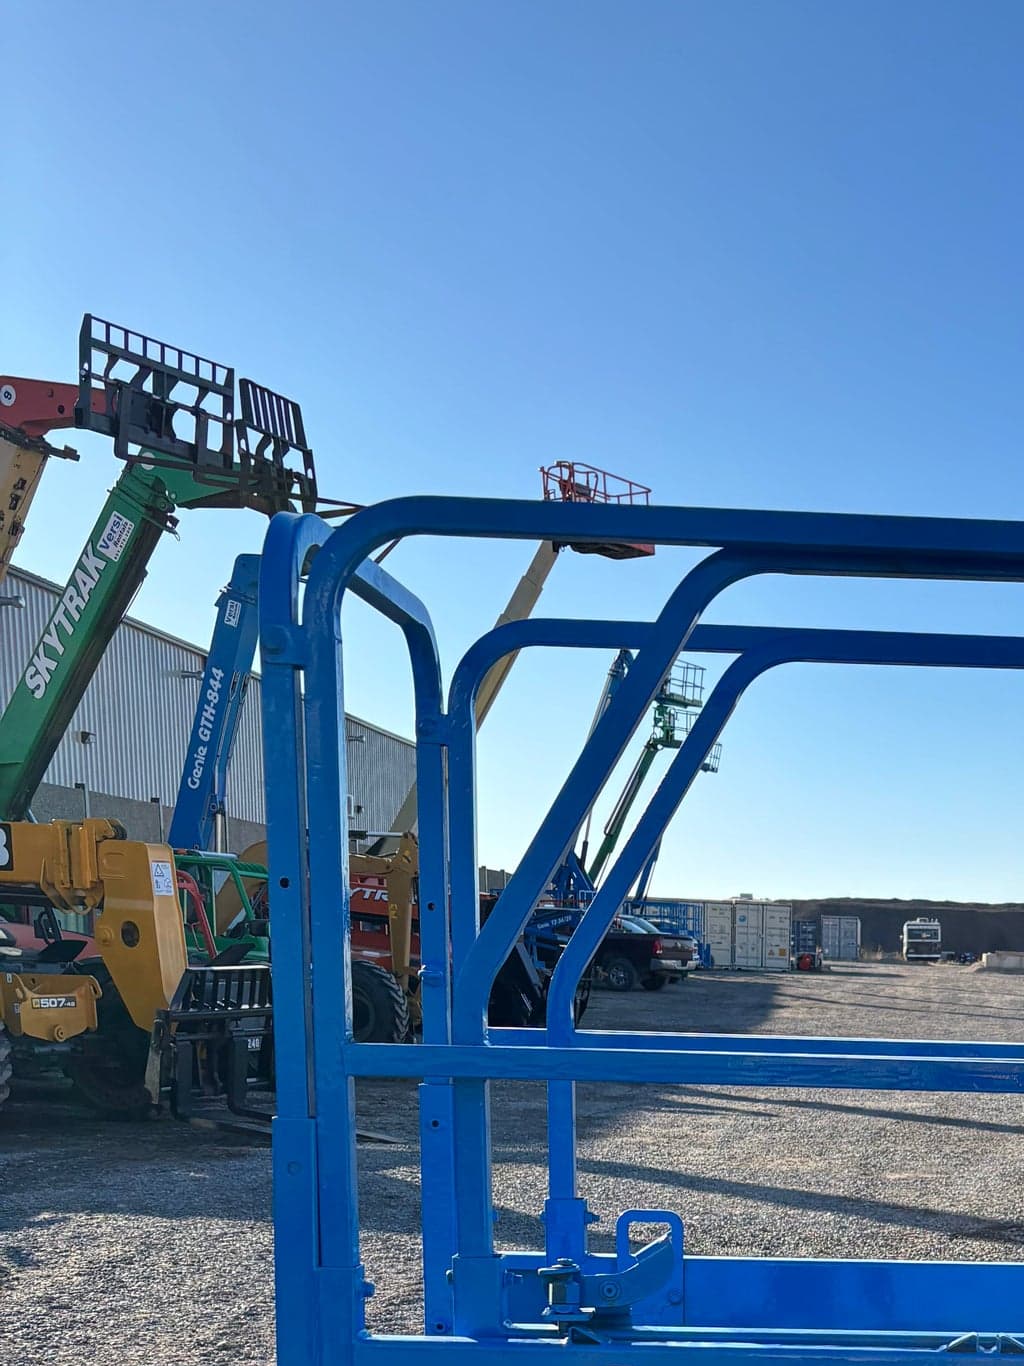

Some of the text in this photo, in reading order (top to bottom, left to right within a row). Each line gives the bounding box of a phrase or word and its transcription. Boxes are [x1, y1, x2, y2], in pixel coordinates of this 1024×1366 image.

[99, 514, 122, 549] Versi
[25, 540, 107, 699] SKYTRAK
[188, 666, 225, 790] Genie GTH-844
